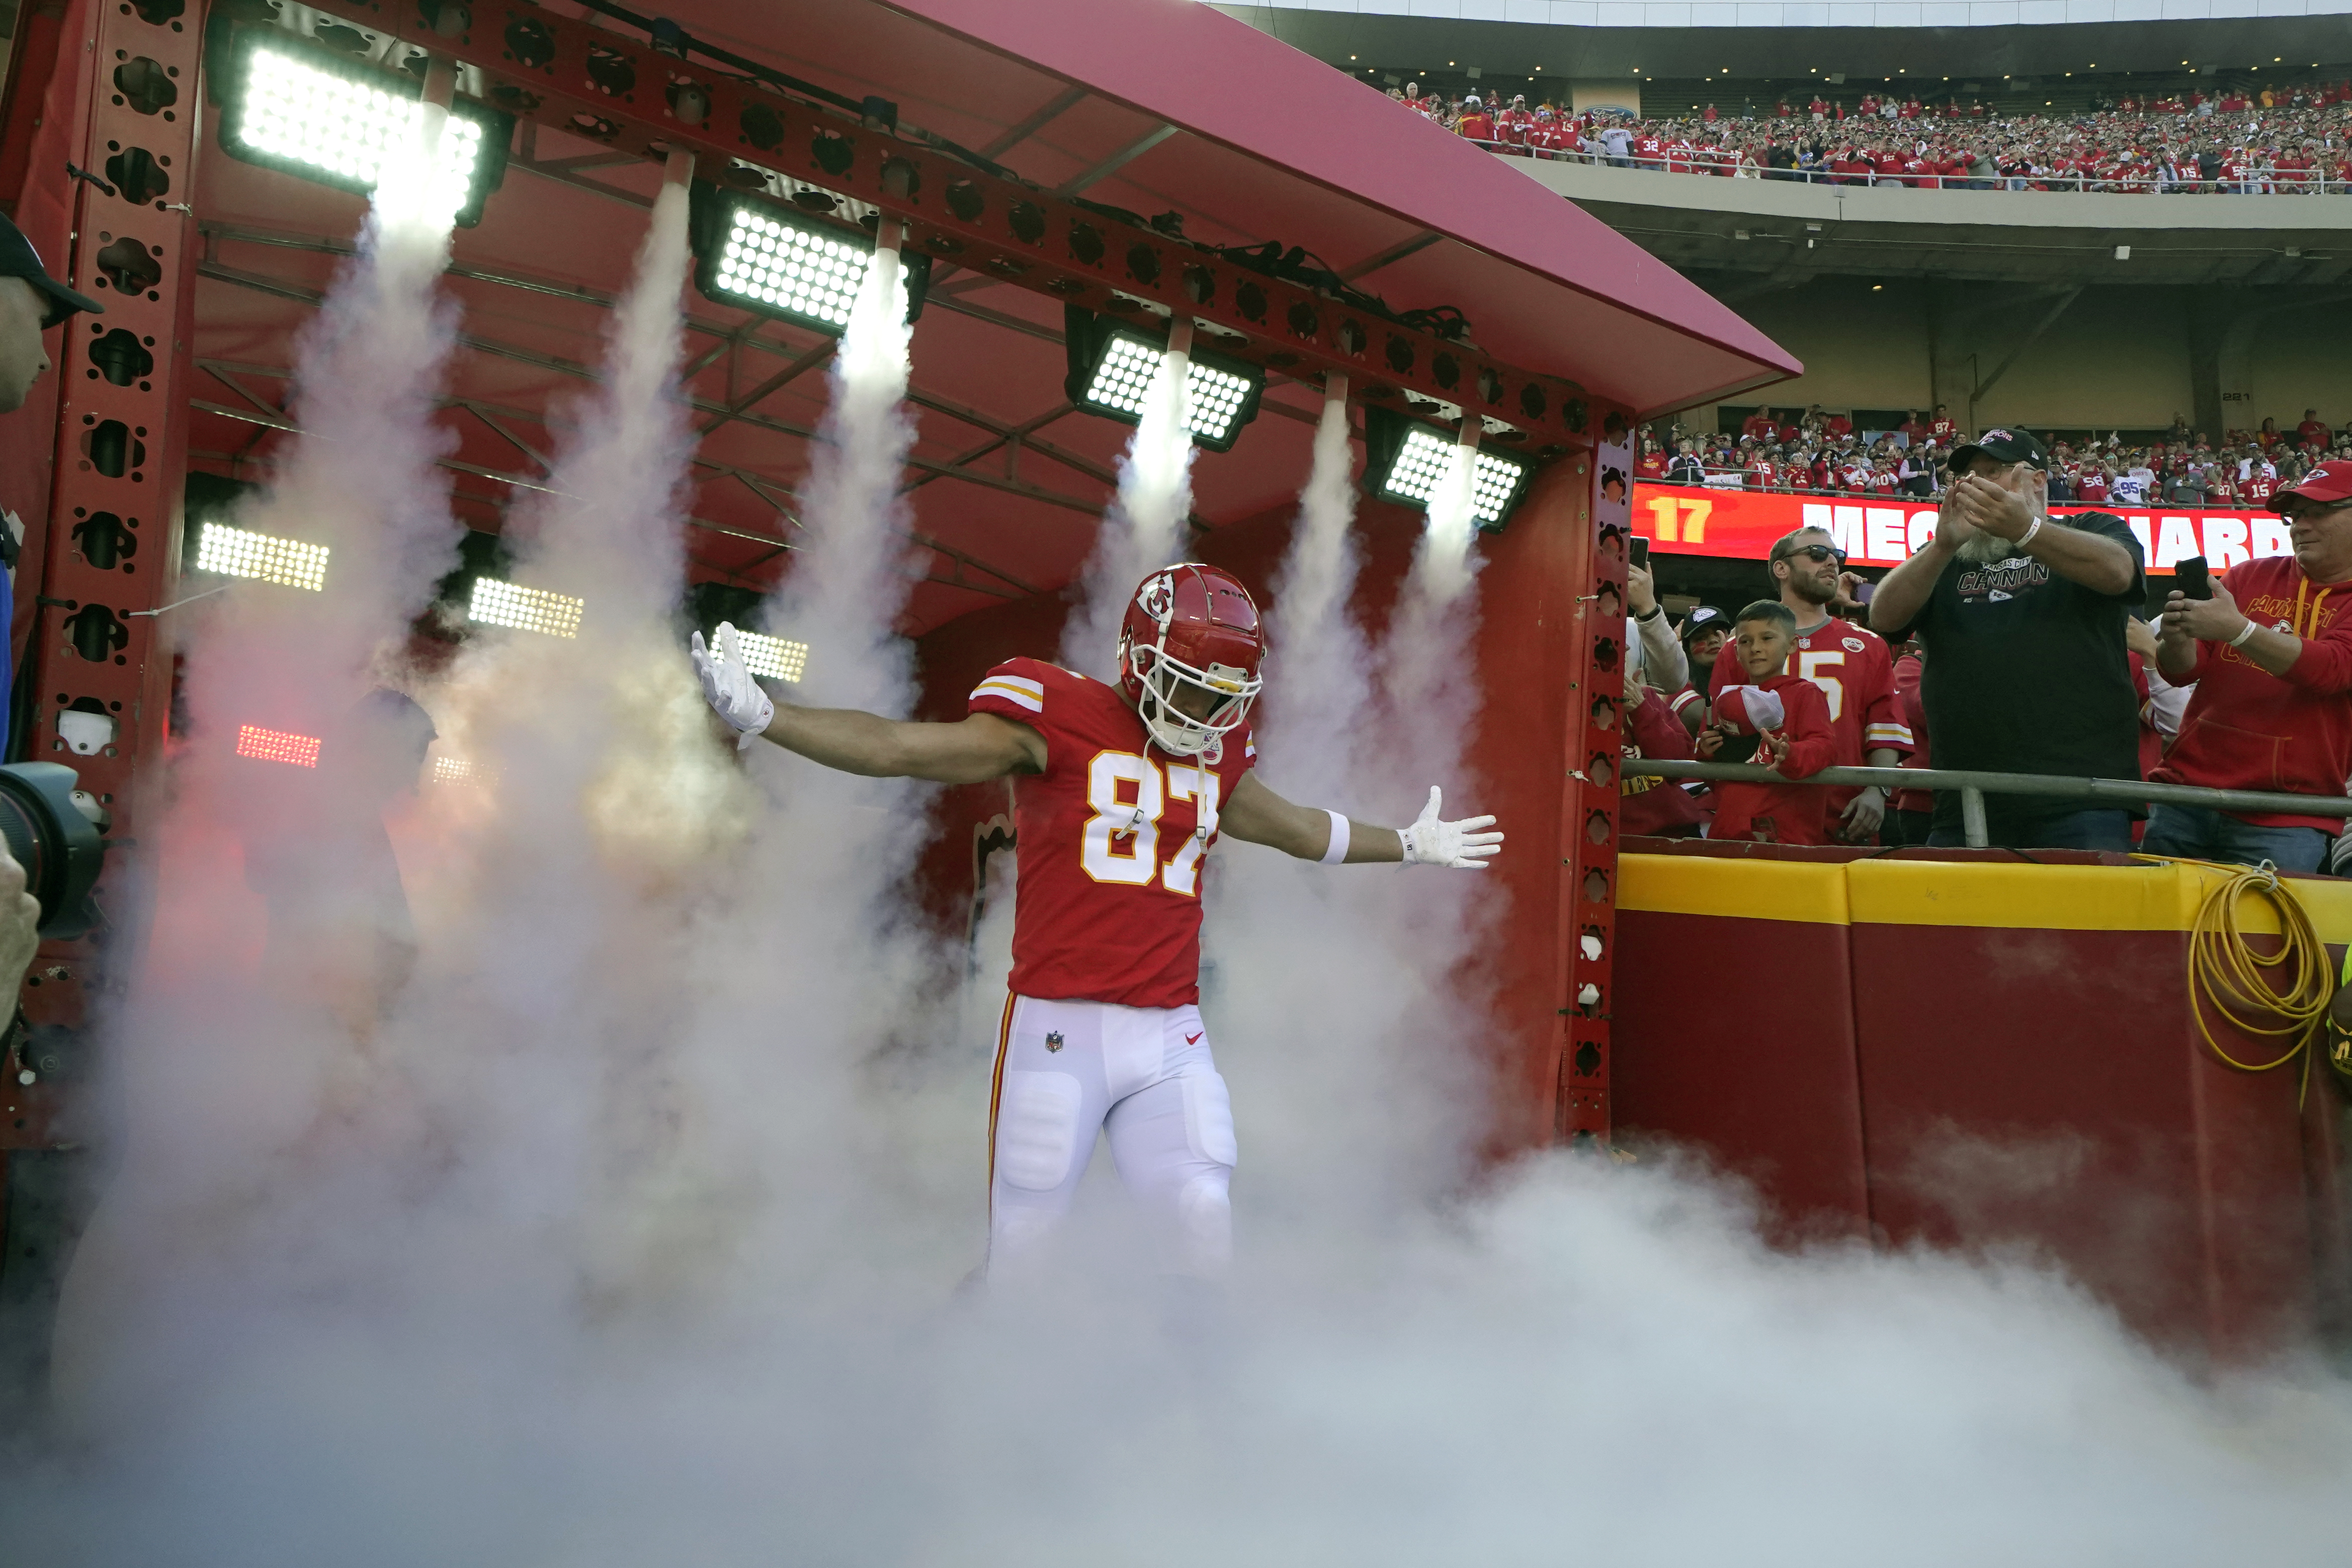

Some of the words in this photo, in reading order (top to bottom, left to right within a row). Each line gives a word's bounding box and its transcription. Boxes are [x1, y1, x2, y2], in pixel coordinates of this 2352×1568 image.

[1561, 121, 1574, 132] 15
[1542, 132, 1551, 145] 7
[1643, 140, 1658, 152] 32
[2180, 167, 2197, 178] 15
[2223, 393, 2249, 401] 221
[1935, 421, 1950, 433] 87
[1756, 462, 1771, 475] 15
[2082, 476, 2105, 488] 58
[2120, 482, 2139, 495] 95
[2218, 484, 2230, 496] 87
[2251, 484, 2270, 498] 15
[1646, 497, 1712, 543] 17
[1983, 559, 2012, 570] KANSAS
[2014, 556, 2032, 567] CITY
[1957, 563, 2049, 592] CANNON
[1080, 749, 1220, 897] 87
